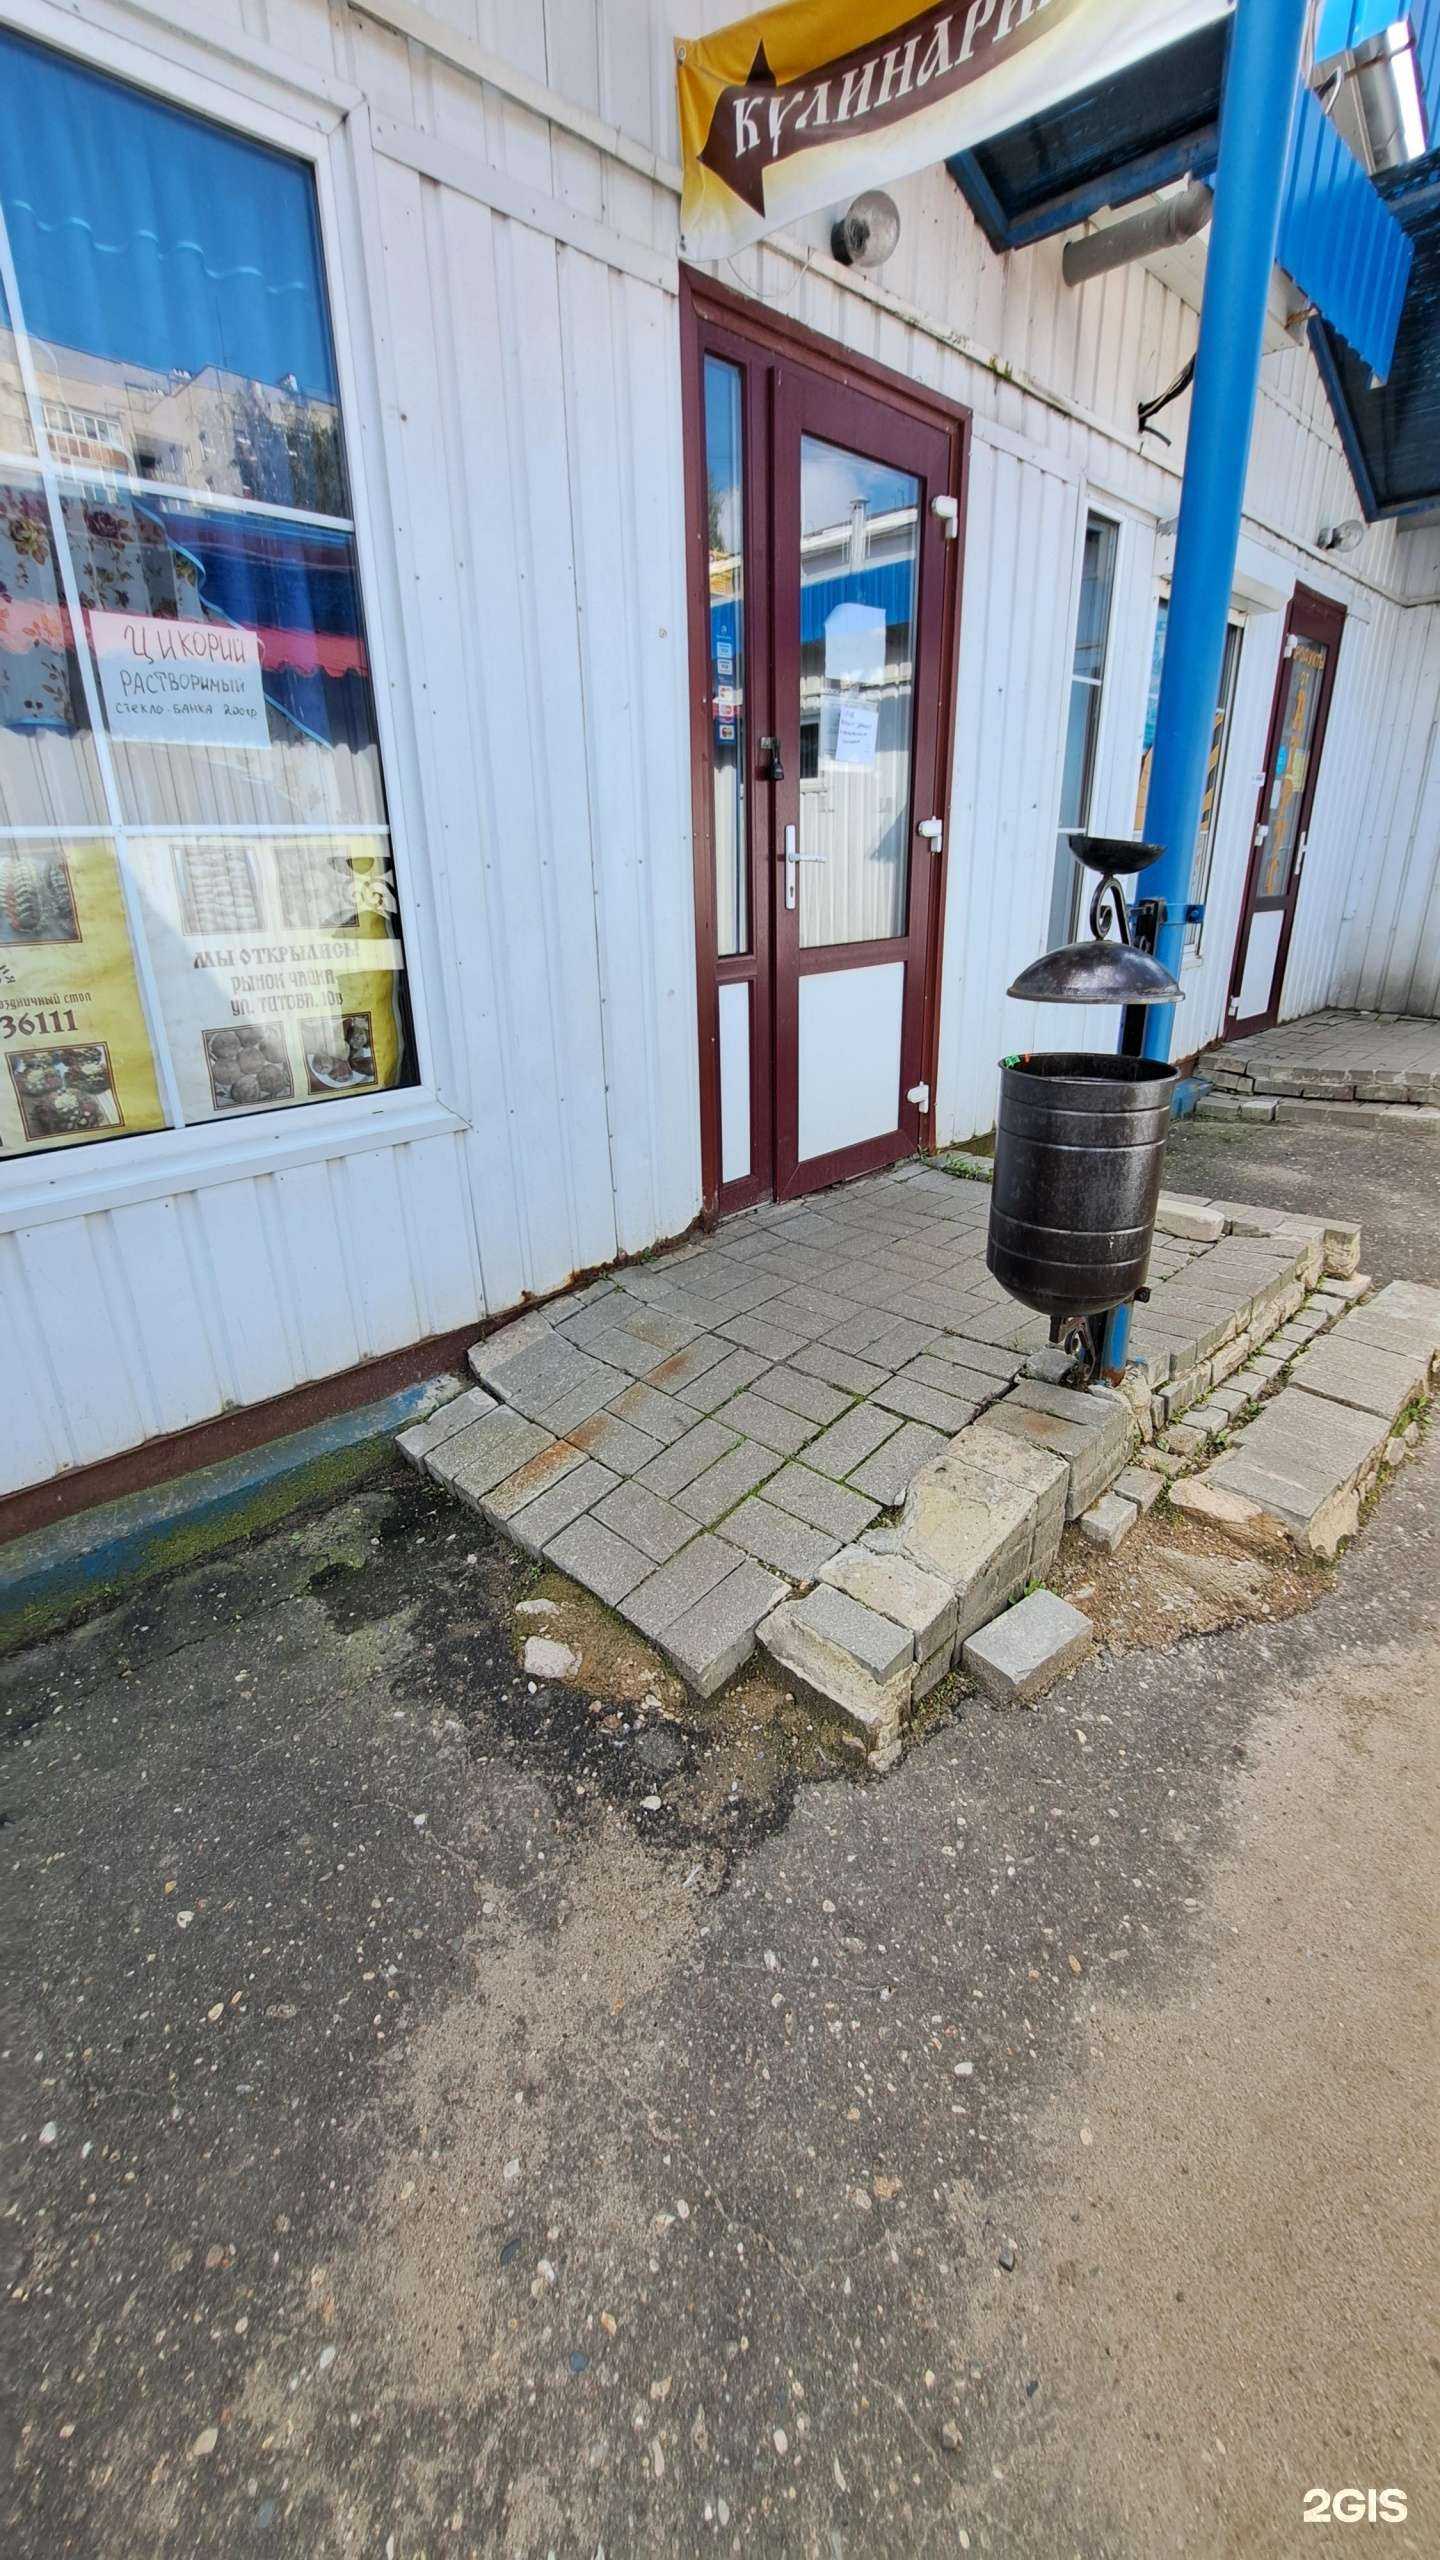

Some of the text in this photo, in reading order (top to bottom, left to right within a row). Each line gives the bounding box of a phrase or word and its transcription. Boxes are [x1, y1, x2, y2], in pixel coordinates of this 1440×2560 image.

[733, 0, 1053, 159] КУЛИНАРИ
[124, 624, 246, 664] ЦИКОРИЙ
[119, 669, 246, 697] РАСТВОРИМЫЙ
[193, 942, 360, 969] МЫ ОТКРЫЛИСЬ!
[0, 1009, 79, 1039] 36111
